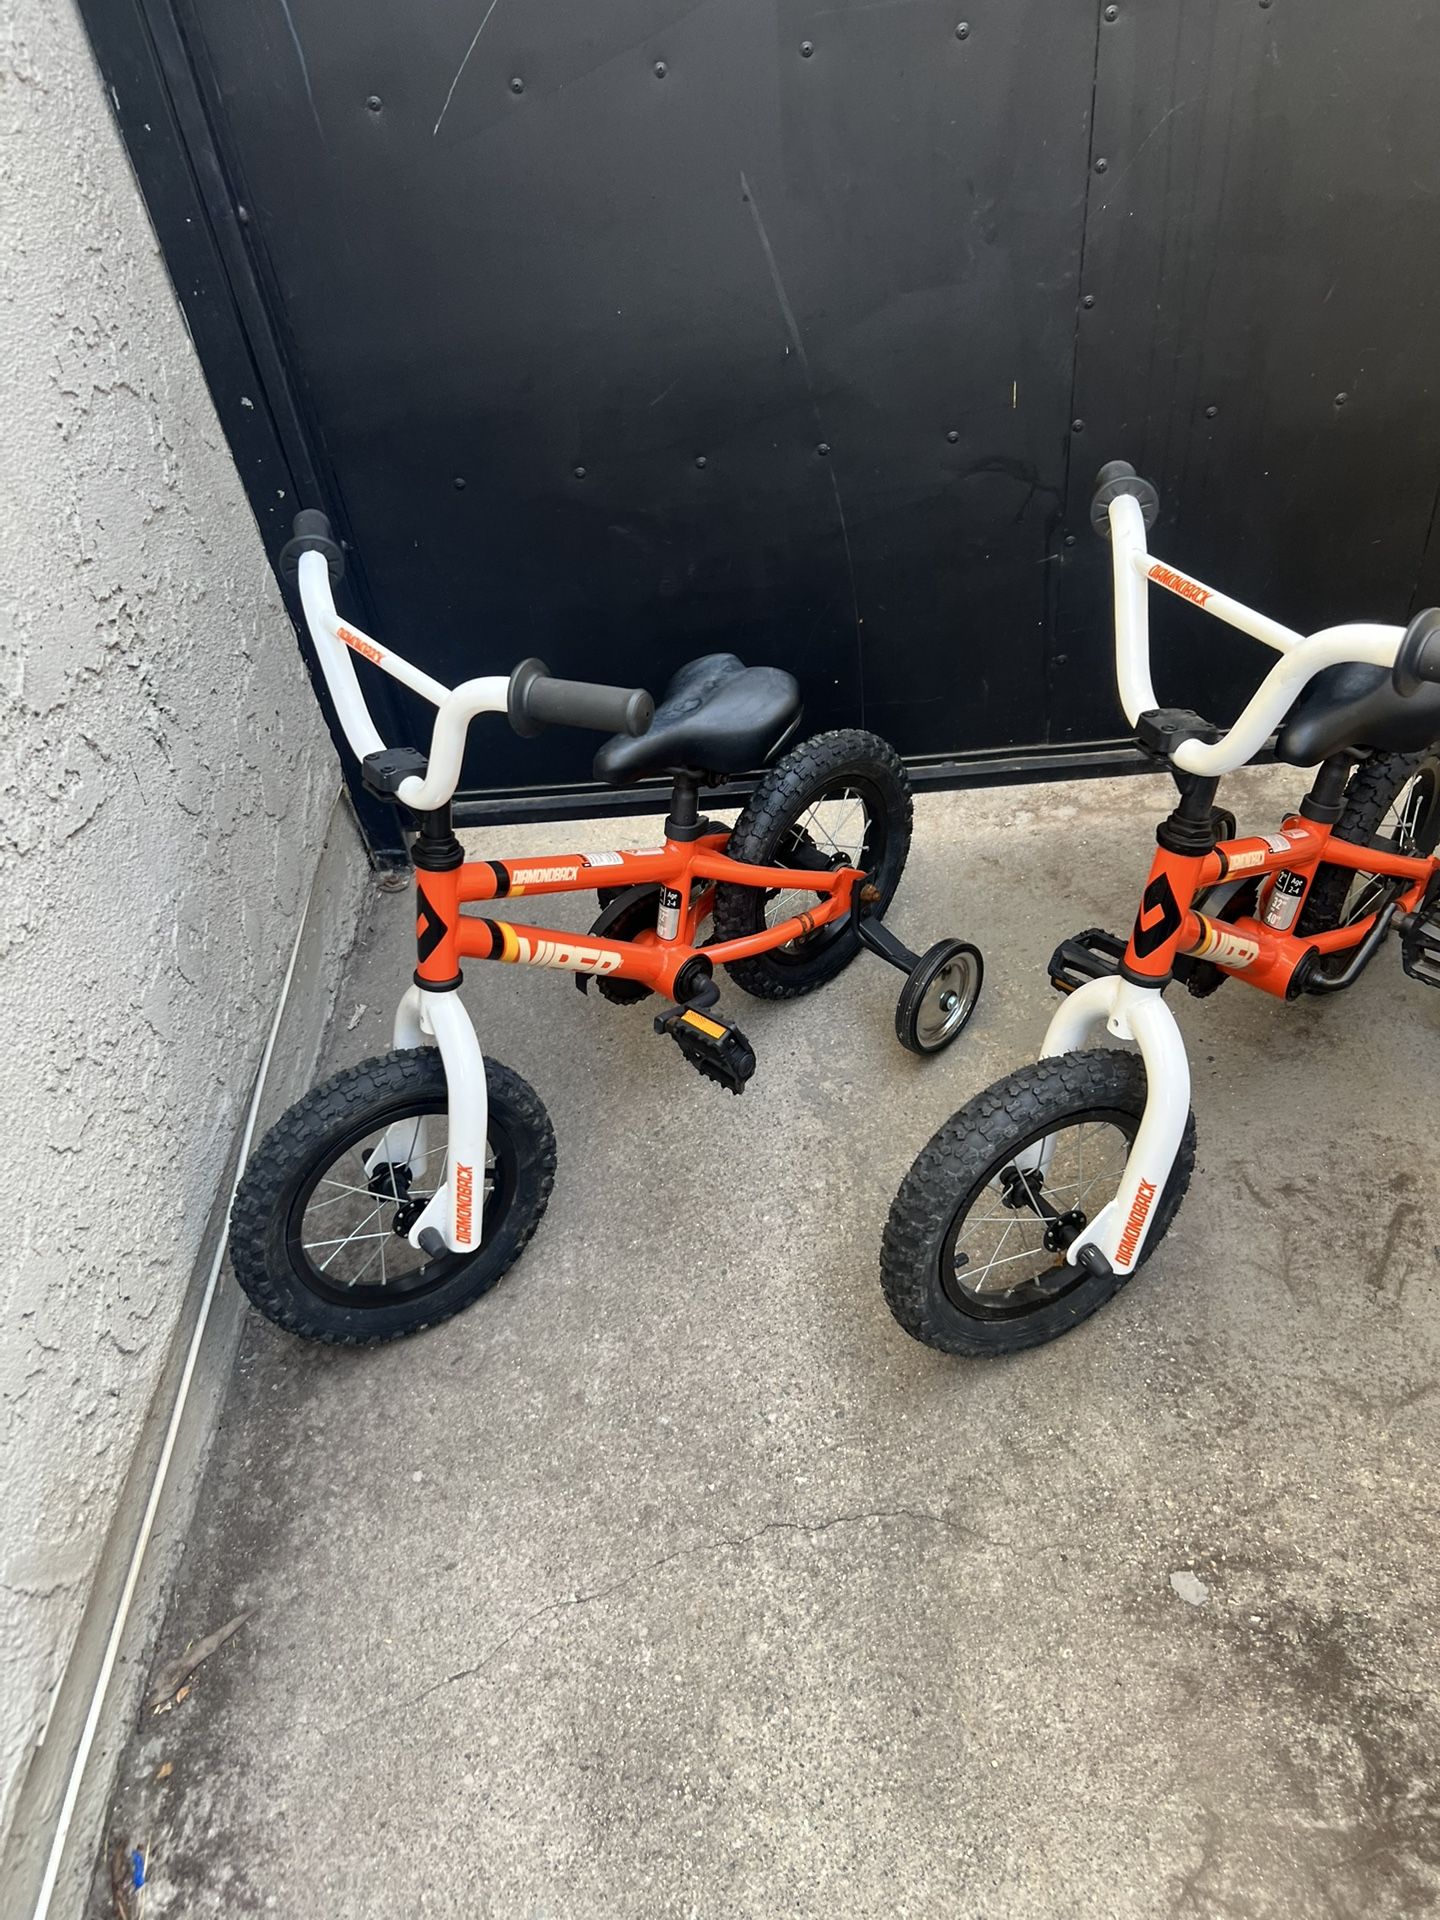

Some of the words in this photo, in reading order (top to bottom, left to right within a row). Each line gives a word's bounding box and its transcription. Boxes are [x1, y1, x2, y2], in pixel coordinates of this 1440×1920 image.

[511, 866, 579, 885] DIAMONDBACK
[1291, 877, 1304, 887] Age
[456, 1162, 473, 1244] DIAMONDBACK
[1114, 1177, 1158, 1267] DIAMONDBACK
